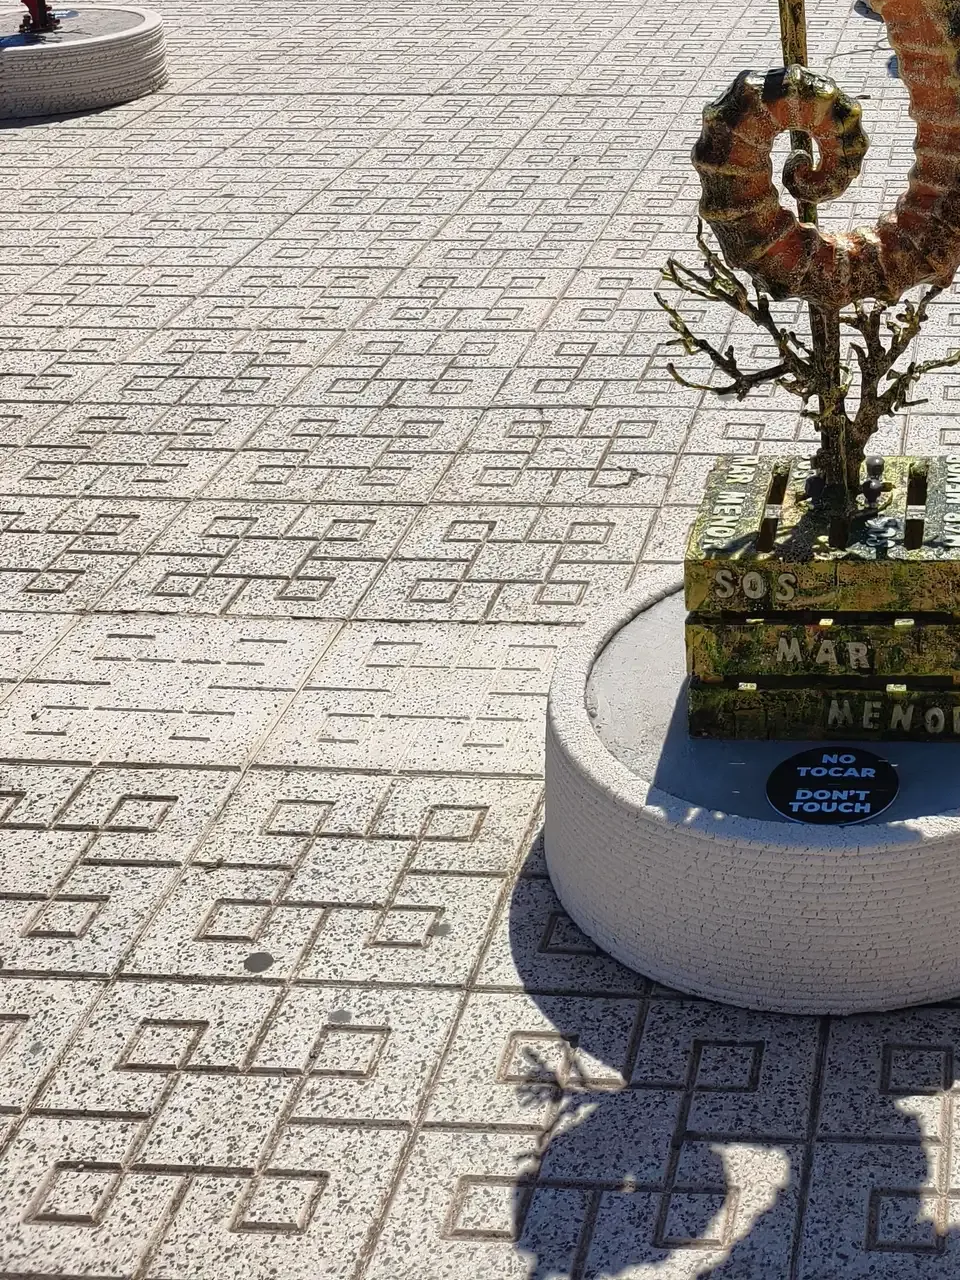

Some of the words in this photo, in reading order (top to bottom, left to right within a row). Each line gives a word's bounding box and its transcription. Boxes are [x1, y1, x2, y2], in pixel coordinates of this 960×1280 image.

[715, 569, 797, 601] SOS
[776, 637, 871, 669] MAR
[821, 753, 857, 764] NO
[796, 766, 876, 778] TOCAR
[795, 789, 871, 801] DON'T
[788, 802, 872, 813] TOUCH
